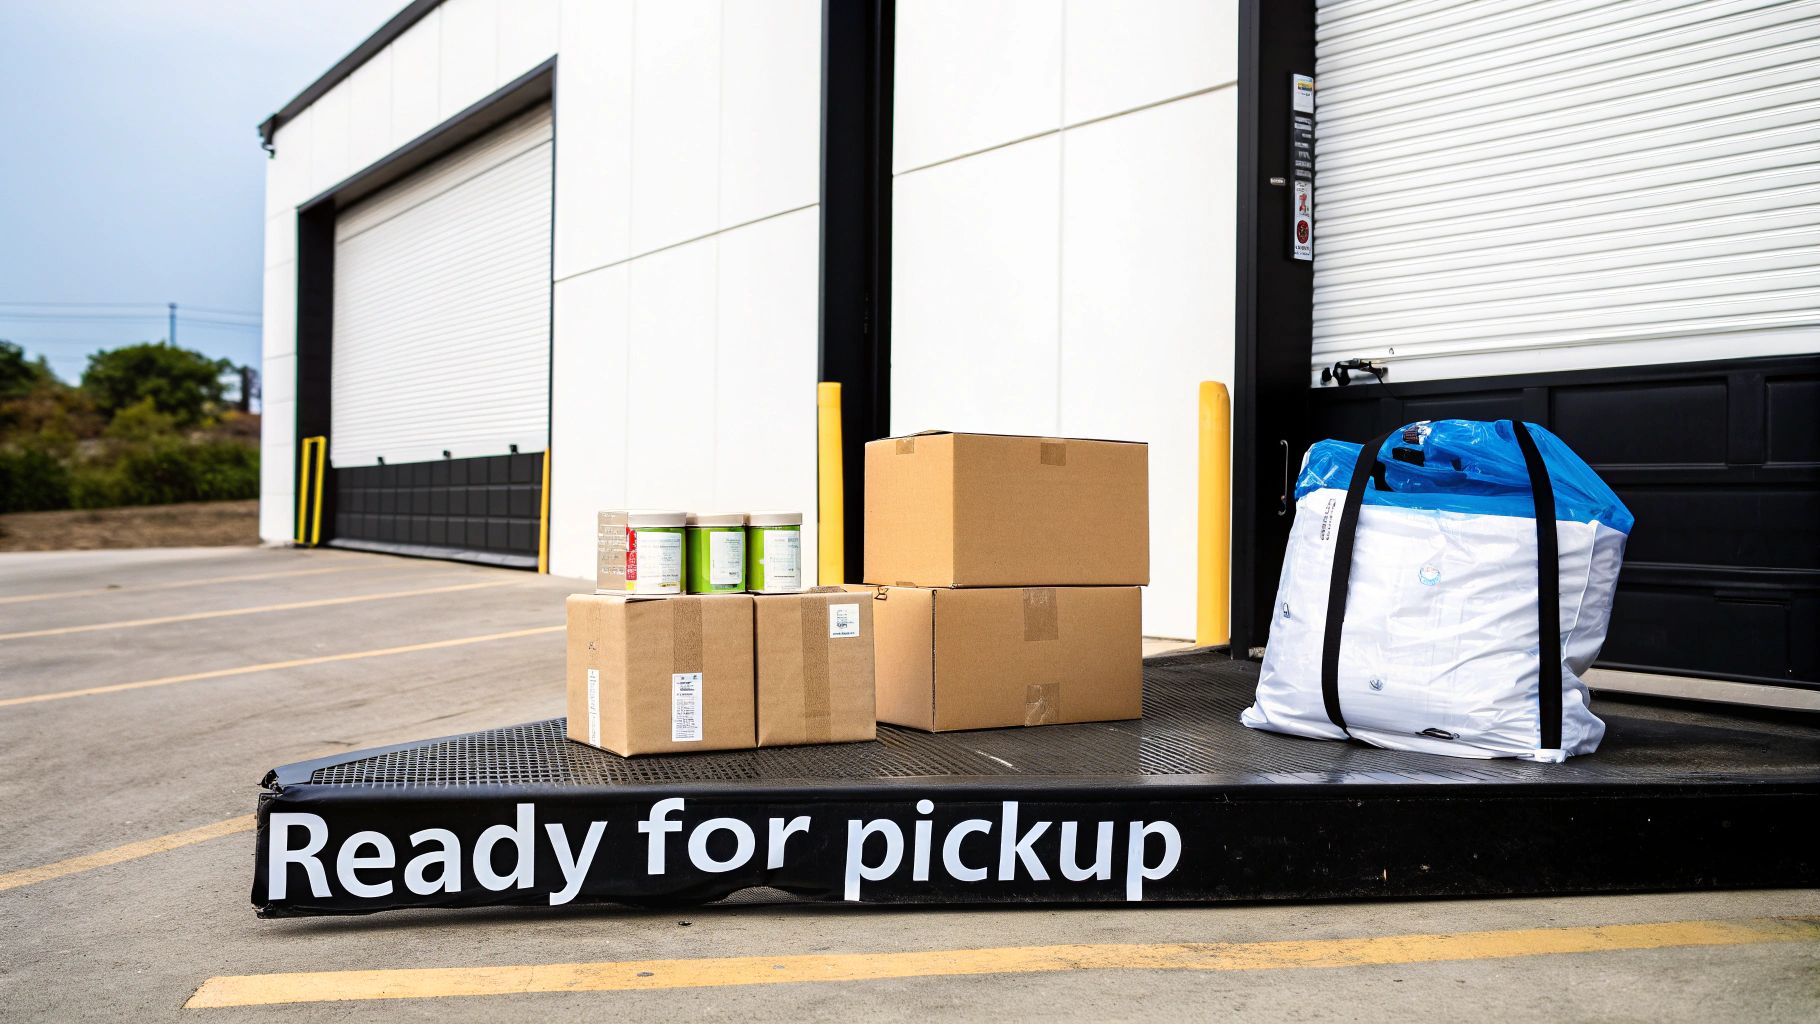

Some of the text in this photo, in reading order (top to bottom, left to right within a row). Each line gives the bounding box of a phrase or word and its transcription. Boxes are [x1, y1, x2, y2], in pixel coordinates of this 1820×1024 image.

[269, 798, 1181, 905] Ready for pickup
